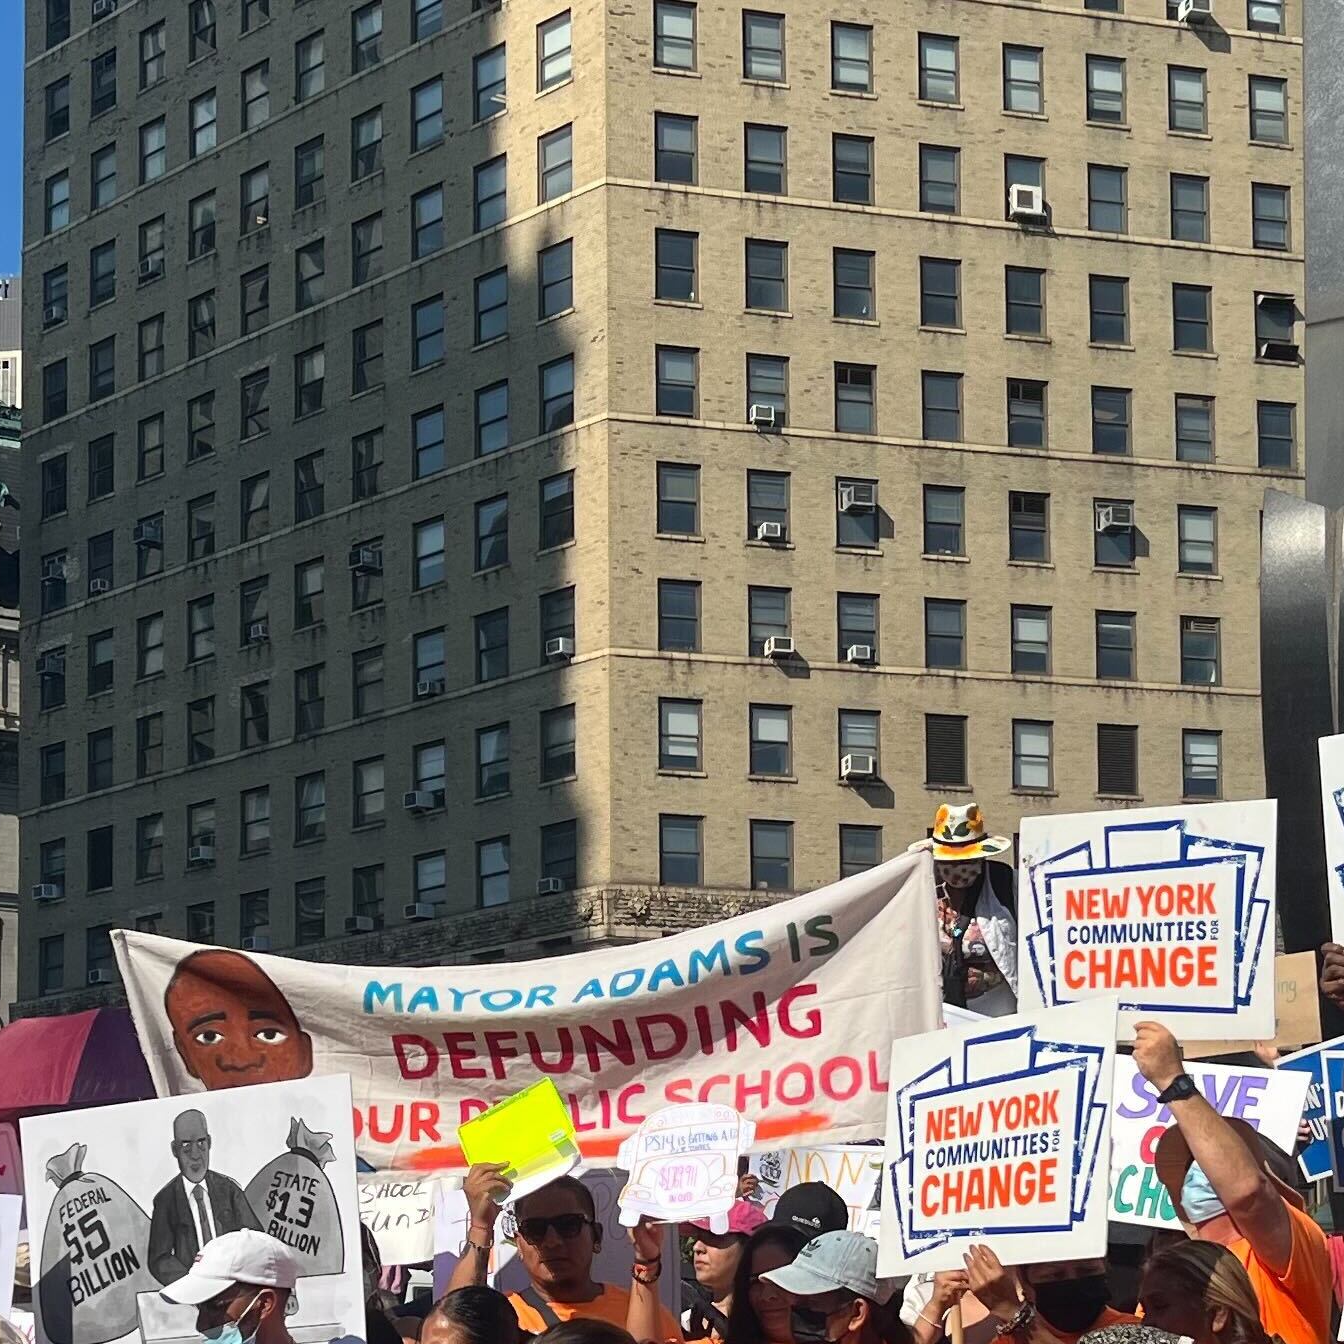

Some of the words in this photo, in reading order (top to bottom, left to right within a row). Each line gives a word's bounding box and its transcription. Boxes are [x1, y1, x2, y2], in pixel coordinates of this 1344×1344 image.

[1065, 886, 1131, 921] NEW
[1136, 882, 1217, 917] YORK
[1066, 921, 1207, 946] COMMUNITIES
[1210, 919, 1218, 941] FOR
[363, 980, 557, 1015] MAYOR
[572, 930, 772, 1004] ADAMS
[785, 914, 840, 963] IS
[1063, 946, 1218, 990] CHANGE
[391, 983, 824, 1081] DEFUNDING
[924, 1103, 985, 1144] NEW
[990, 1089, 1060, 1134] YORK
[924, 1131, 1050, 1170] COMMUNITIES
[1052, 1128, 1060, 1152] FOR
[58, 1186, 112, 1224] FEDERAL
[270, 1170, 320, 1197] STATE
[919, 1158, 1058, 1219] CHANGE
[265, 1189, 316, 1229] $1.3
[63, 1208, 112, 1266] $5
[264, 1221, 322, 1257] BILLION
[66, 1243, 141, 1309] BILLION
